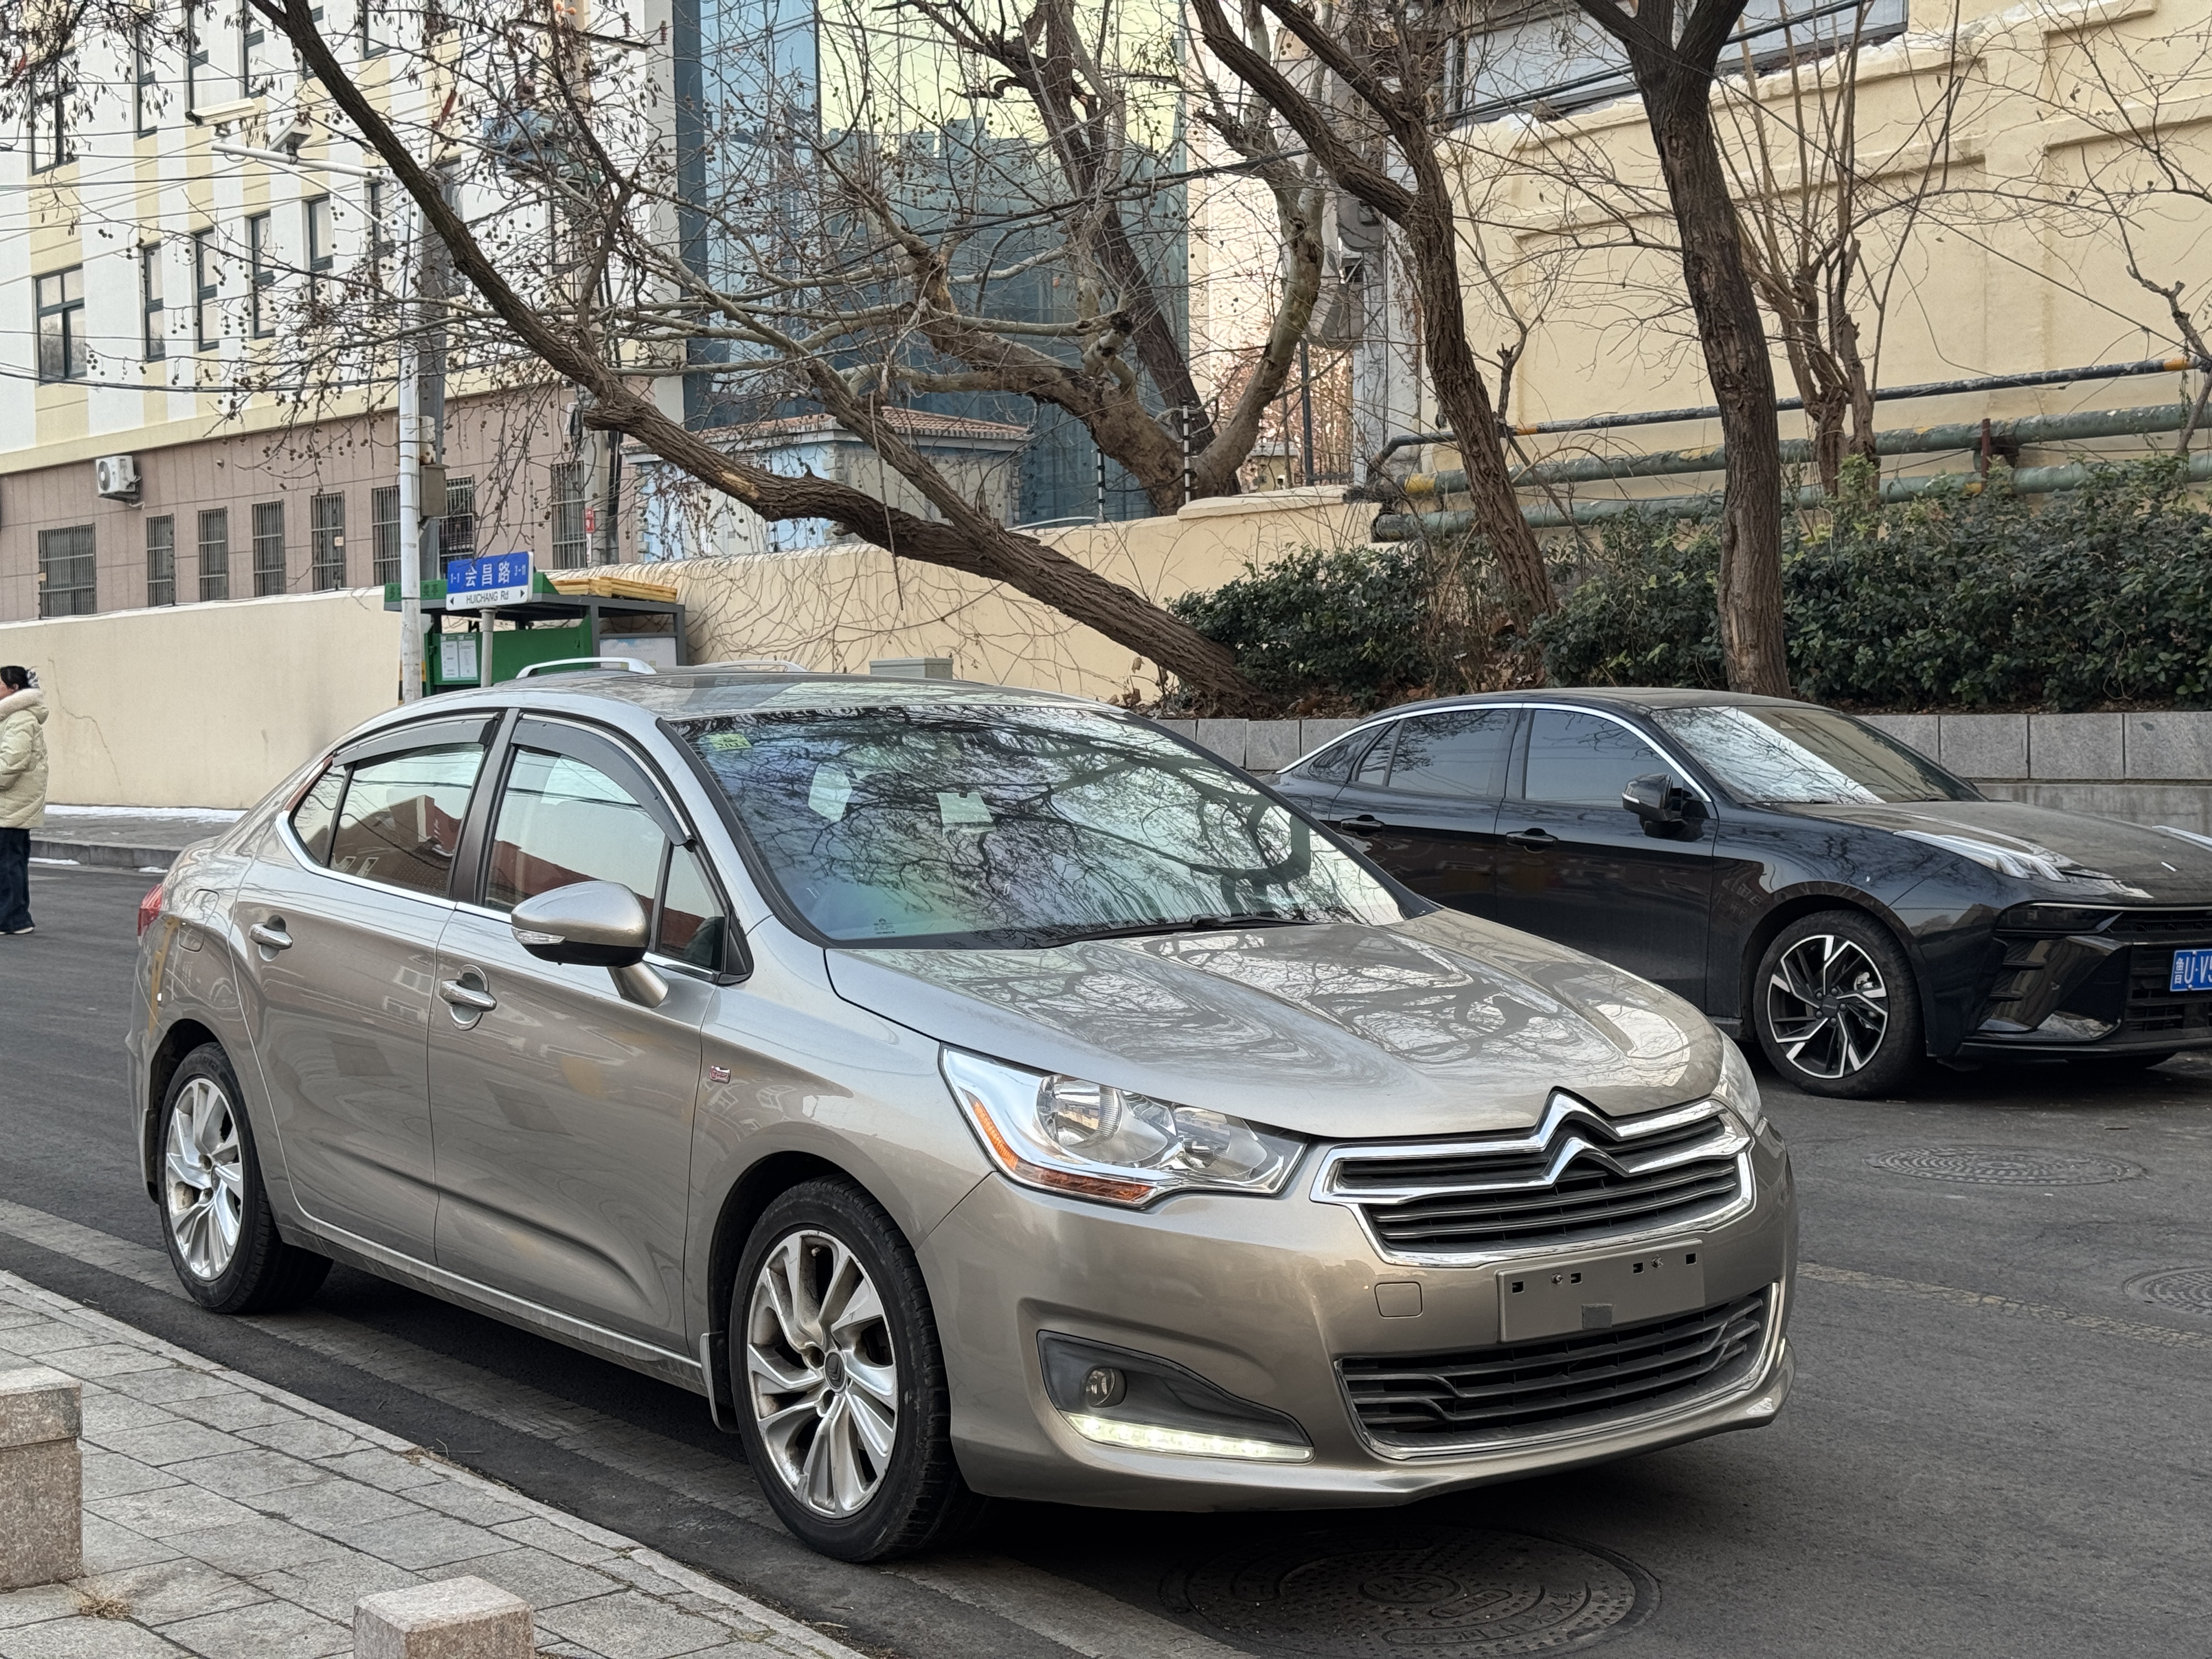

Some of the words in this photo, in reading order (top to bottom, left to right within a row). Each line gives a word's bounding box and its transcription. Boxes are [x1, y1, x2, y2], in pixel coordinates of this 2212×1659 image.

[465, 561, 511, 587] 会昌路
[466, 591, 498, 605] HUICHANG
[500, 590, 509, 601] Rd
